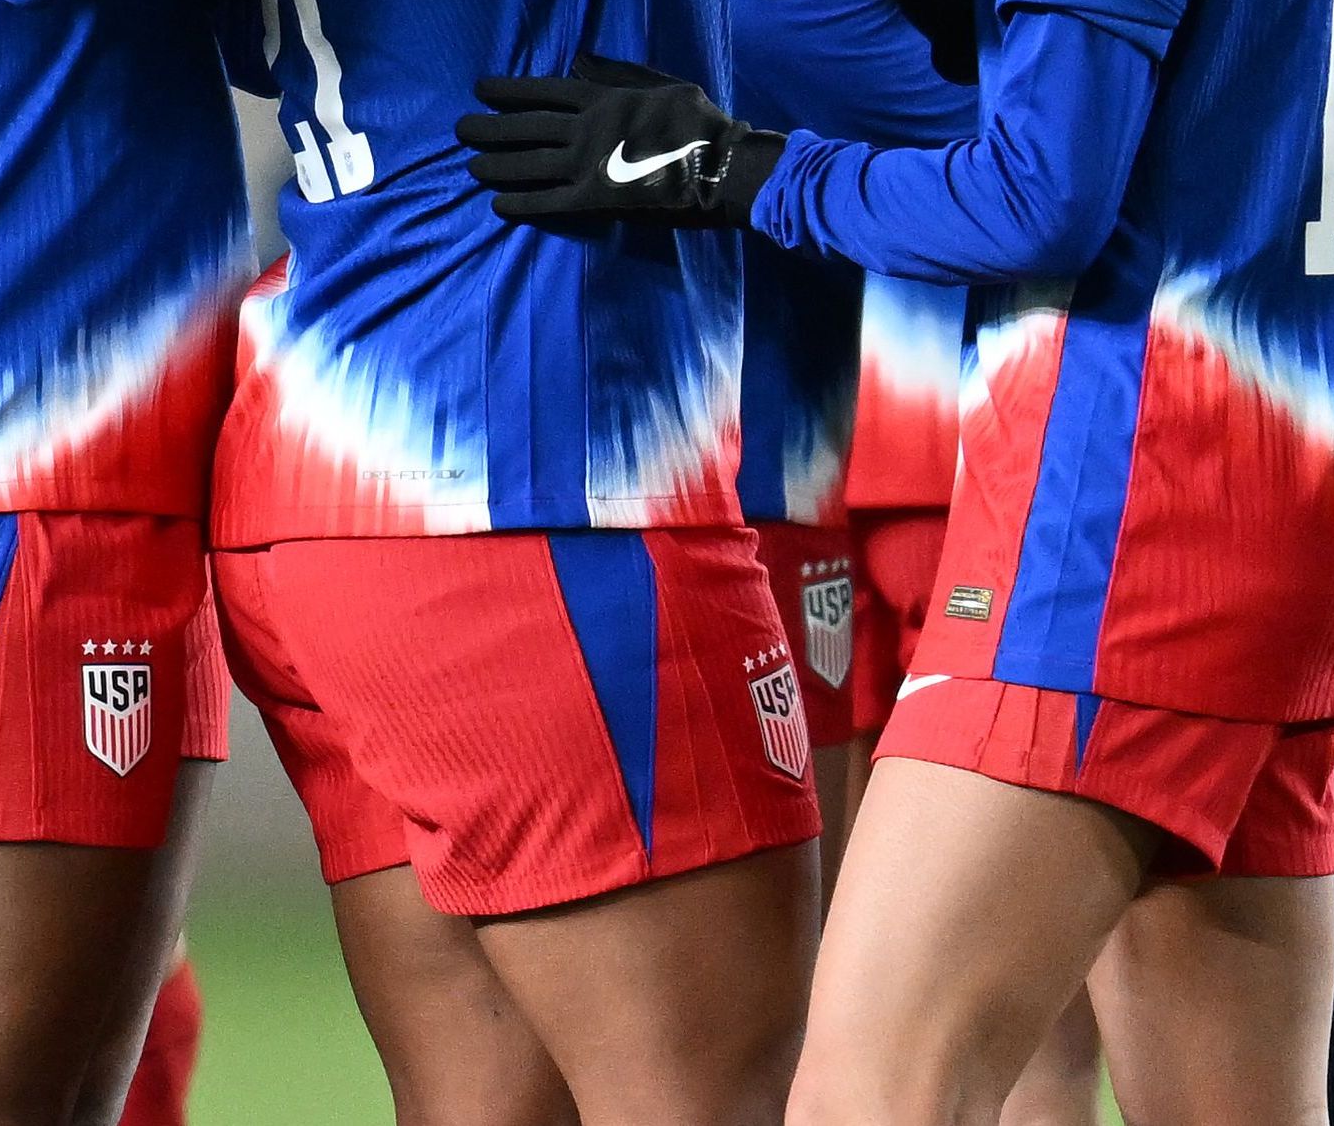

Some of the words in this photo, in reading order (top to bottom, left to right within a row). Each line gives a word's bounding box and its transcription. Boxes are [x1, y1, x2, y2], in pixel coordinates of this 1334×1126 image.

[807, 583, 850, 626] USA
[88, 669, 149, 712] USA
[756, 670, 796, 717] USA
